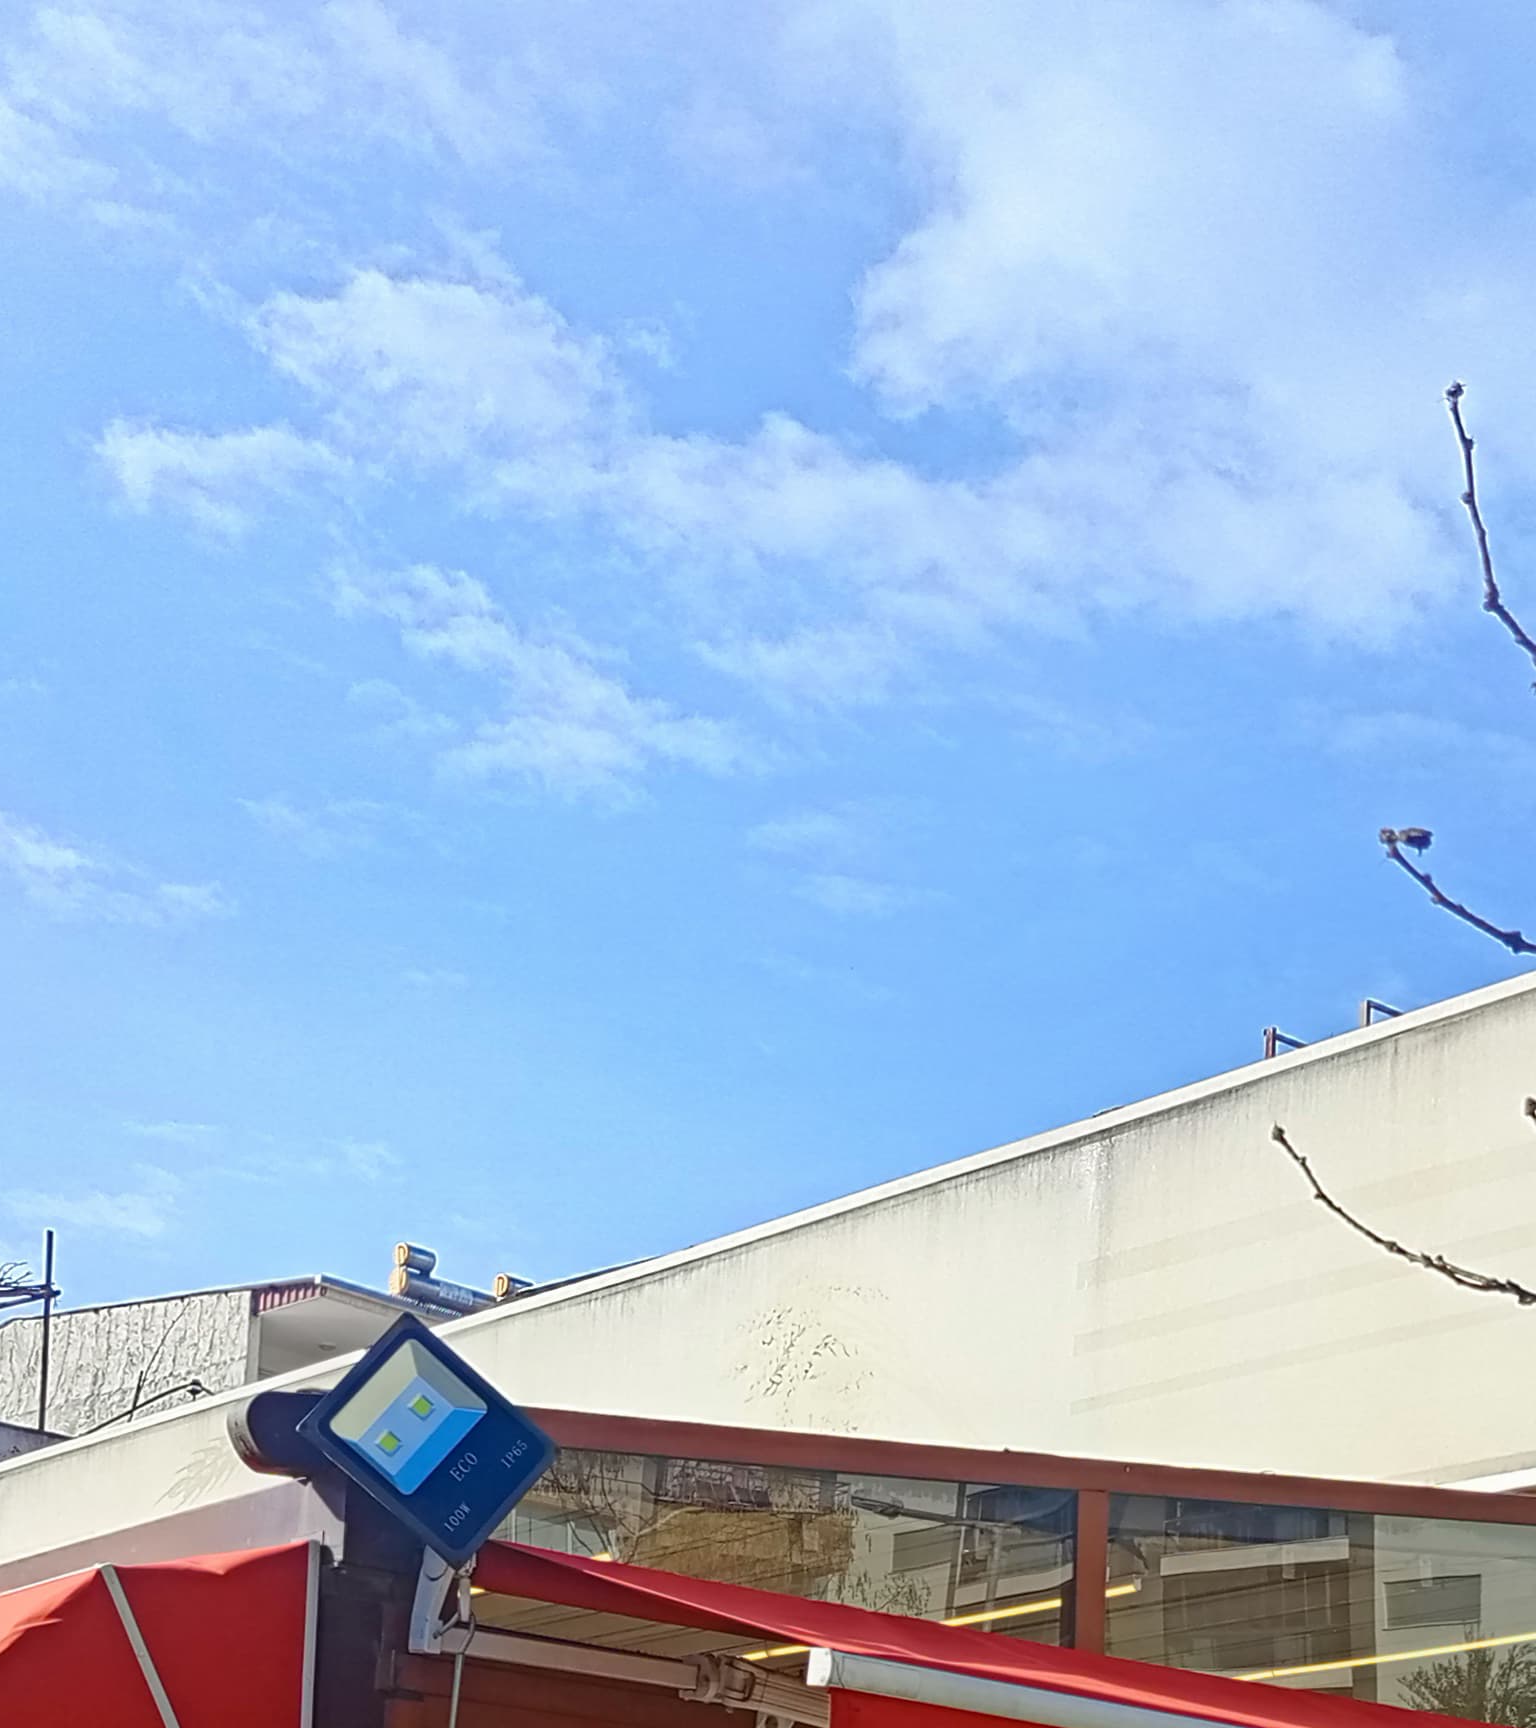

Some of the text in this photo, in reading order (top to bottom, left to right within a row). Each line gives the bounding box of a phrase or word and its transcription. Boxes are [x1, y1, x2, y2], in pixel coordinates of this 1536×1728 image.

[449, 1452, 478, 1482] ECO
[500, 1439, 529, 1469] IP65
[443, 1501, 471, 1533] 100W
